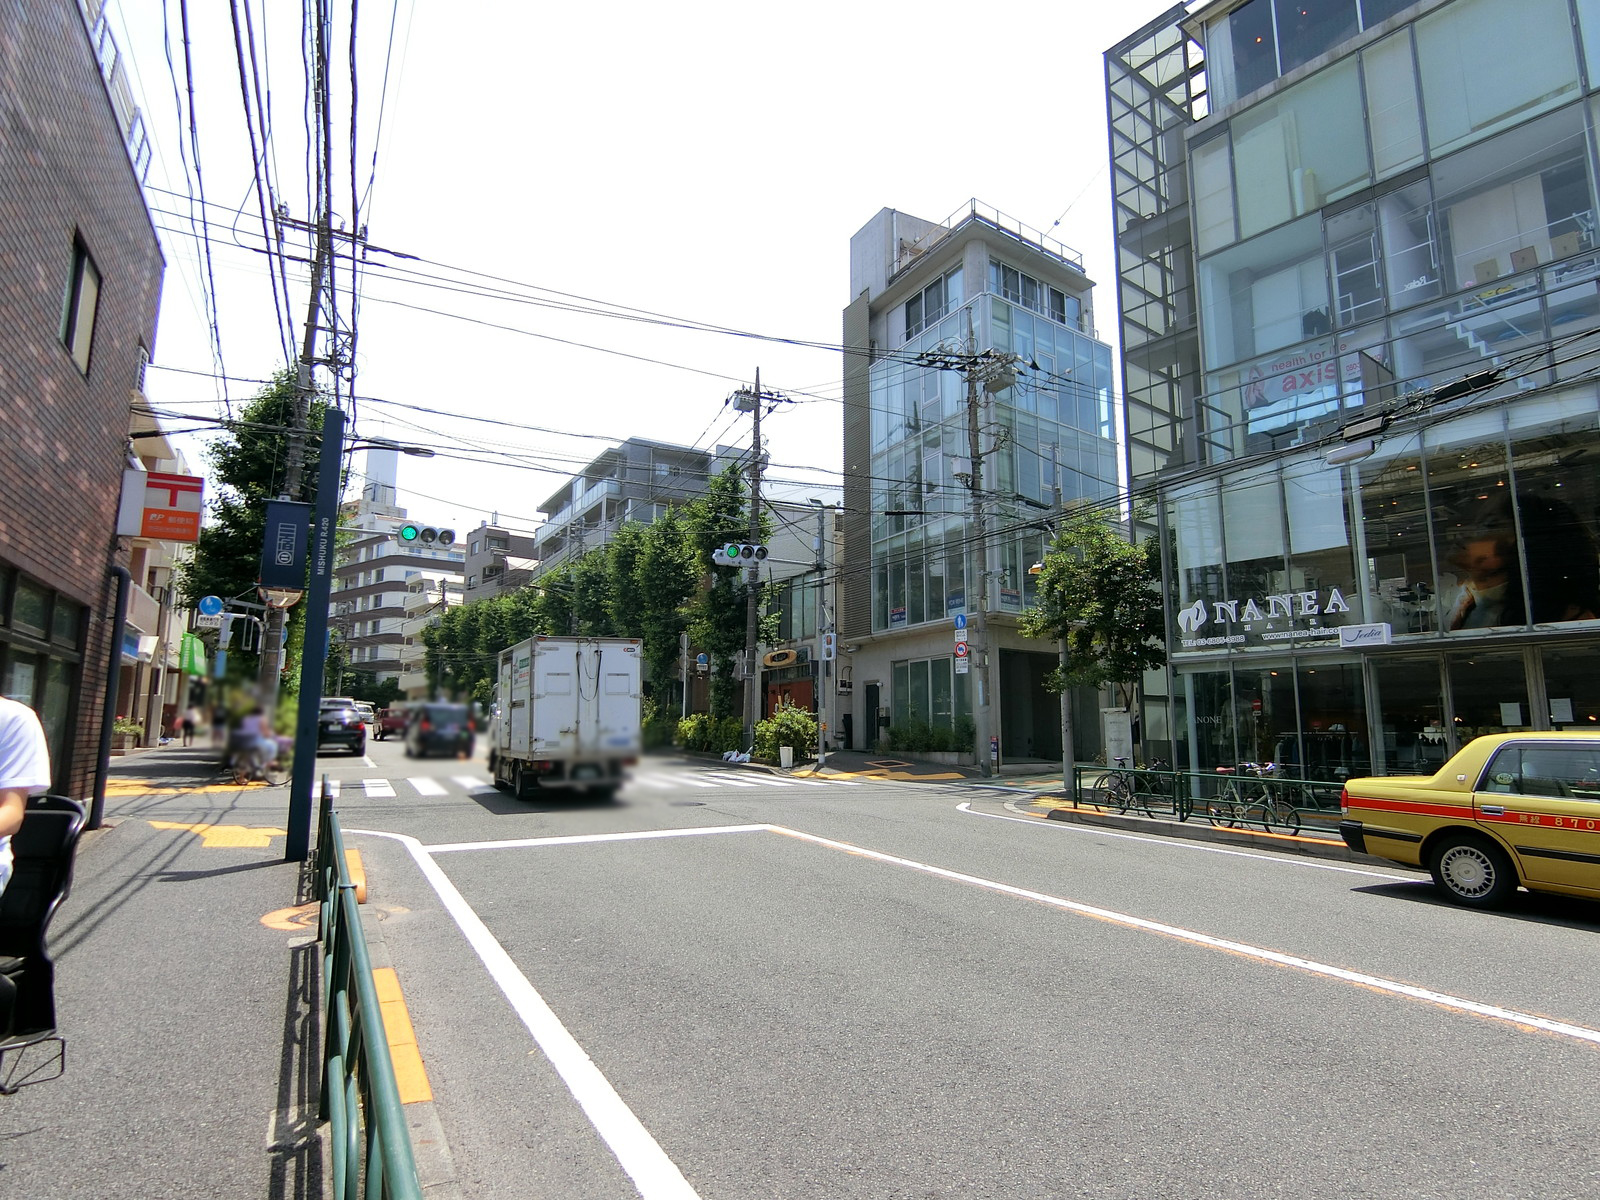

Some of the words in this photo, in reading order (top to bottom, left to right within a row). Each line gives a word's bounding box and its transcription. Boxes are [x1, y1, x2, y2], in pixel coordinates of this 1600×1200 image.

[1282, 362, 1336, 393] axis
[317, 538, 328, 576] MISHUKU
[1212, 588, 1350, 624] NANEA
